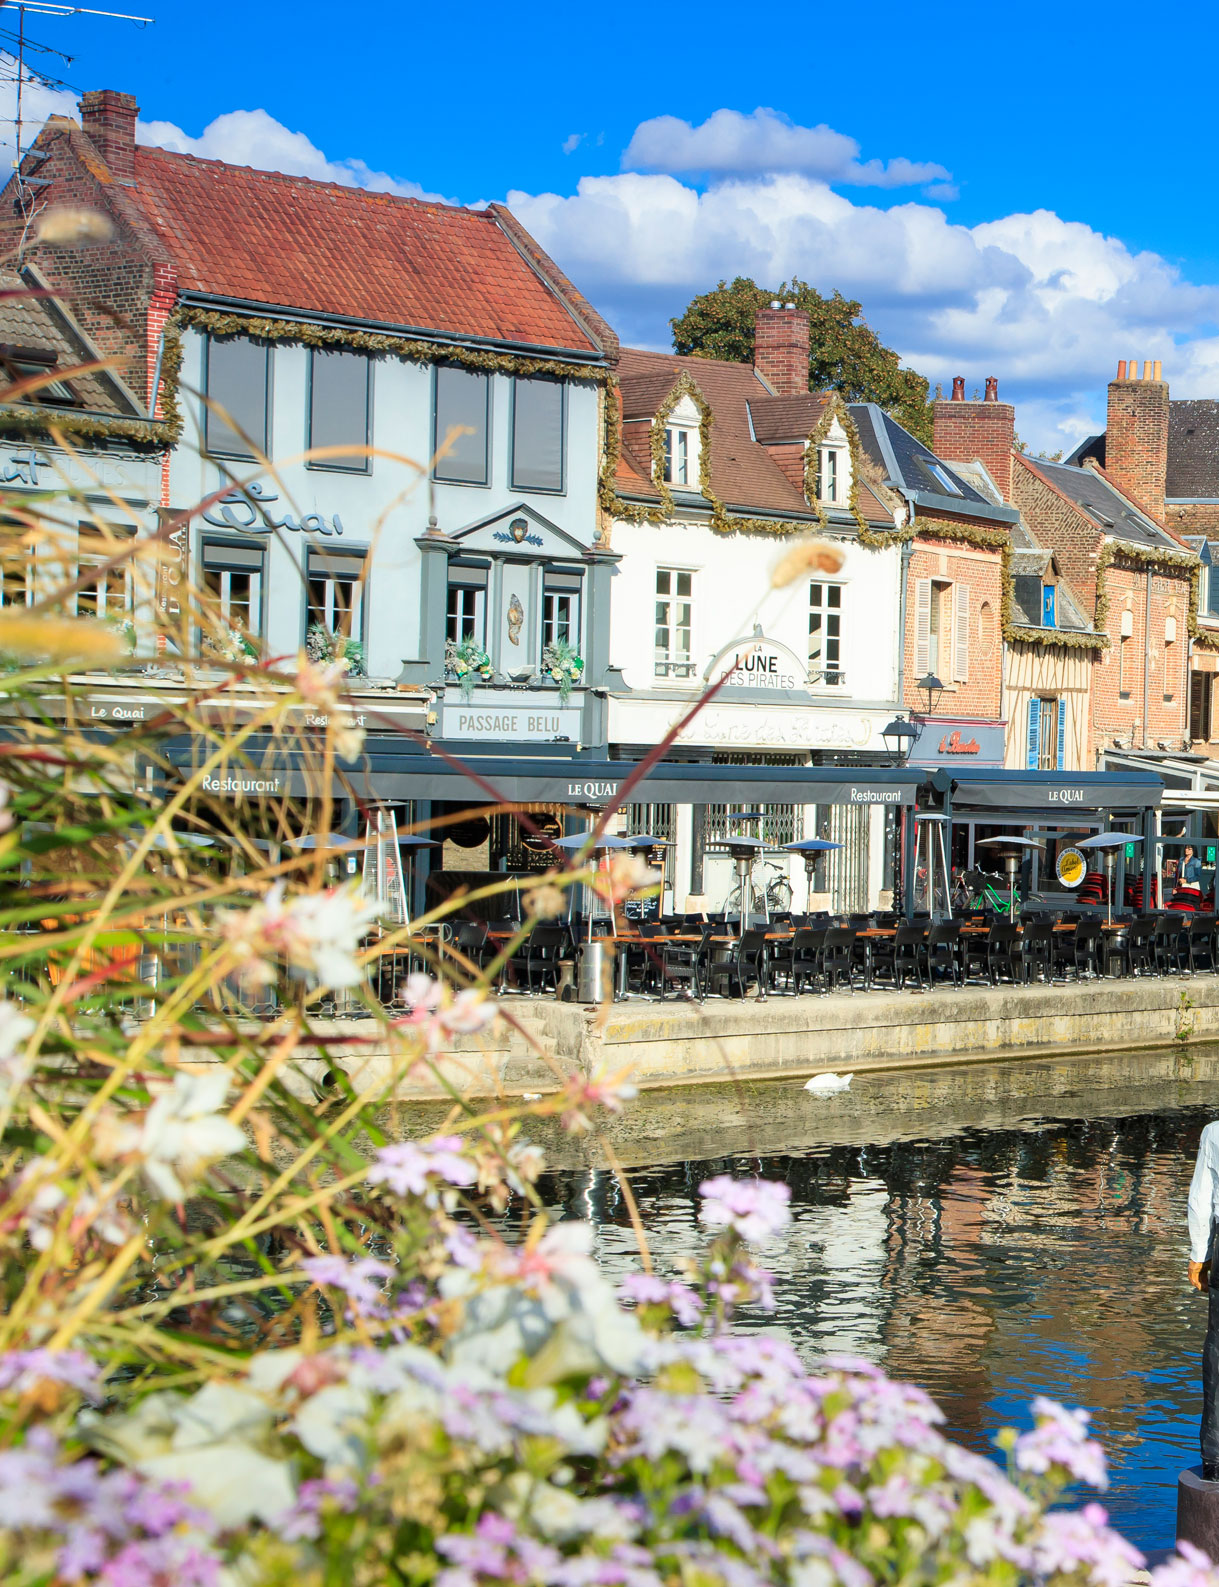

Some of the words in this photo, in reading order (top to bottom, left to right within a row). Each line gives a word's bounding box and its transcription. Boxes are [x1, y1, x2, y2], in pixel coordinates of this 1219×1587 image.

[202, 487, 344, 536] Quai
[735, 654, 778, 673] LUNE
[720, 671, 745, 687] DES
[748, 672, 795, 689] PIRATES
[90, 706, 107, 717] Le
[112, 706, 144, 719] Quai
[305, 714, 367, 726] Restant
[459, 714, 518, 732] PASSAGE
[527, 716, 560, 733] BELU
[202, 774, 280, 792] Restaurant
[568, 784, 582, 796] LE
[583, 782, 618, 799] QUAI
[851, 787, 902, 802] Restaurant
[1048, 791, 1059, 801] LE
[1059, 789, 1084, 804] QUAI
